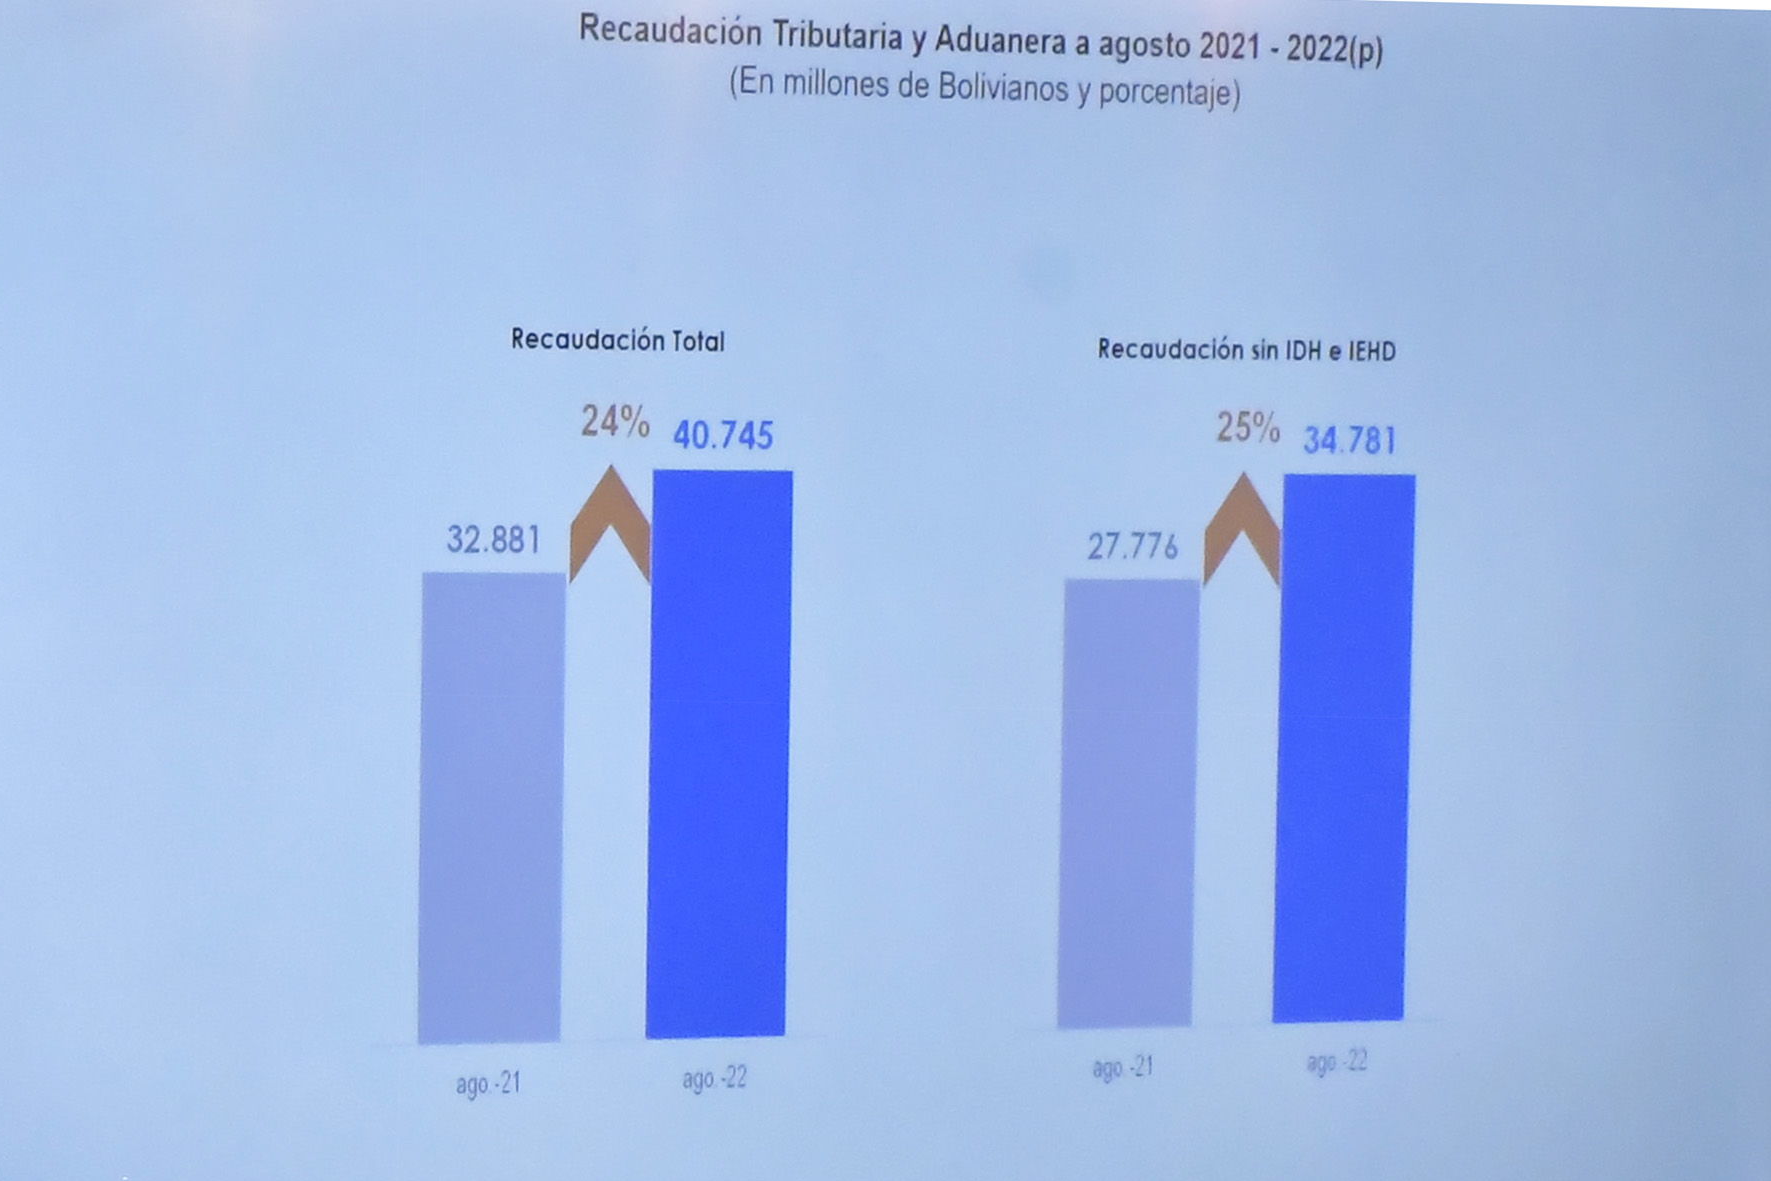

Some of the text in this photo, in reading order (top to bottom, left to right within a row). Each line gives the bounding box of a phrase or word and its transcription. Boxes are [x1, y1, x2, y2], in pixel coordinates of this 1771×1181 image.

[580, 13, 762, 46] Recaudación
[772, 19, 903, 51] Tributaria
[912, 30, 927, 58] y
[935, 24, 1066, 55] Aduanera
[1075, 35, 1090, 55] a
[1099, 33, 1191, 64] agosto
[1200, 31, 1258, 60] 2021
[1287, 33, 1384, 69] 2022(p)
[730, 65, 1241, 113] (En millones de Bolivianos y porcentaje)
[512, 326, 725, 352] Recaudación Total
[1098, 336, 1397, 362] Recaudación sin IDH e IEHD
[581, 403, 651, 438] 24%
[673, 419, 774, 451] 40.745
[1216, 410, 1281, 444] 25%
[1303, 425, 1395, 455] 34.781
[446, 524, 539, 554] 32.881
[1087, 531, 1179, 561] 27.776
